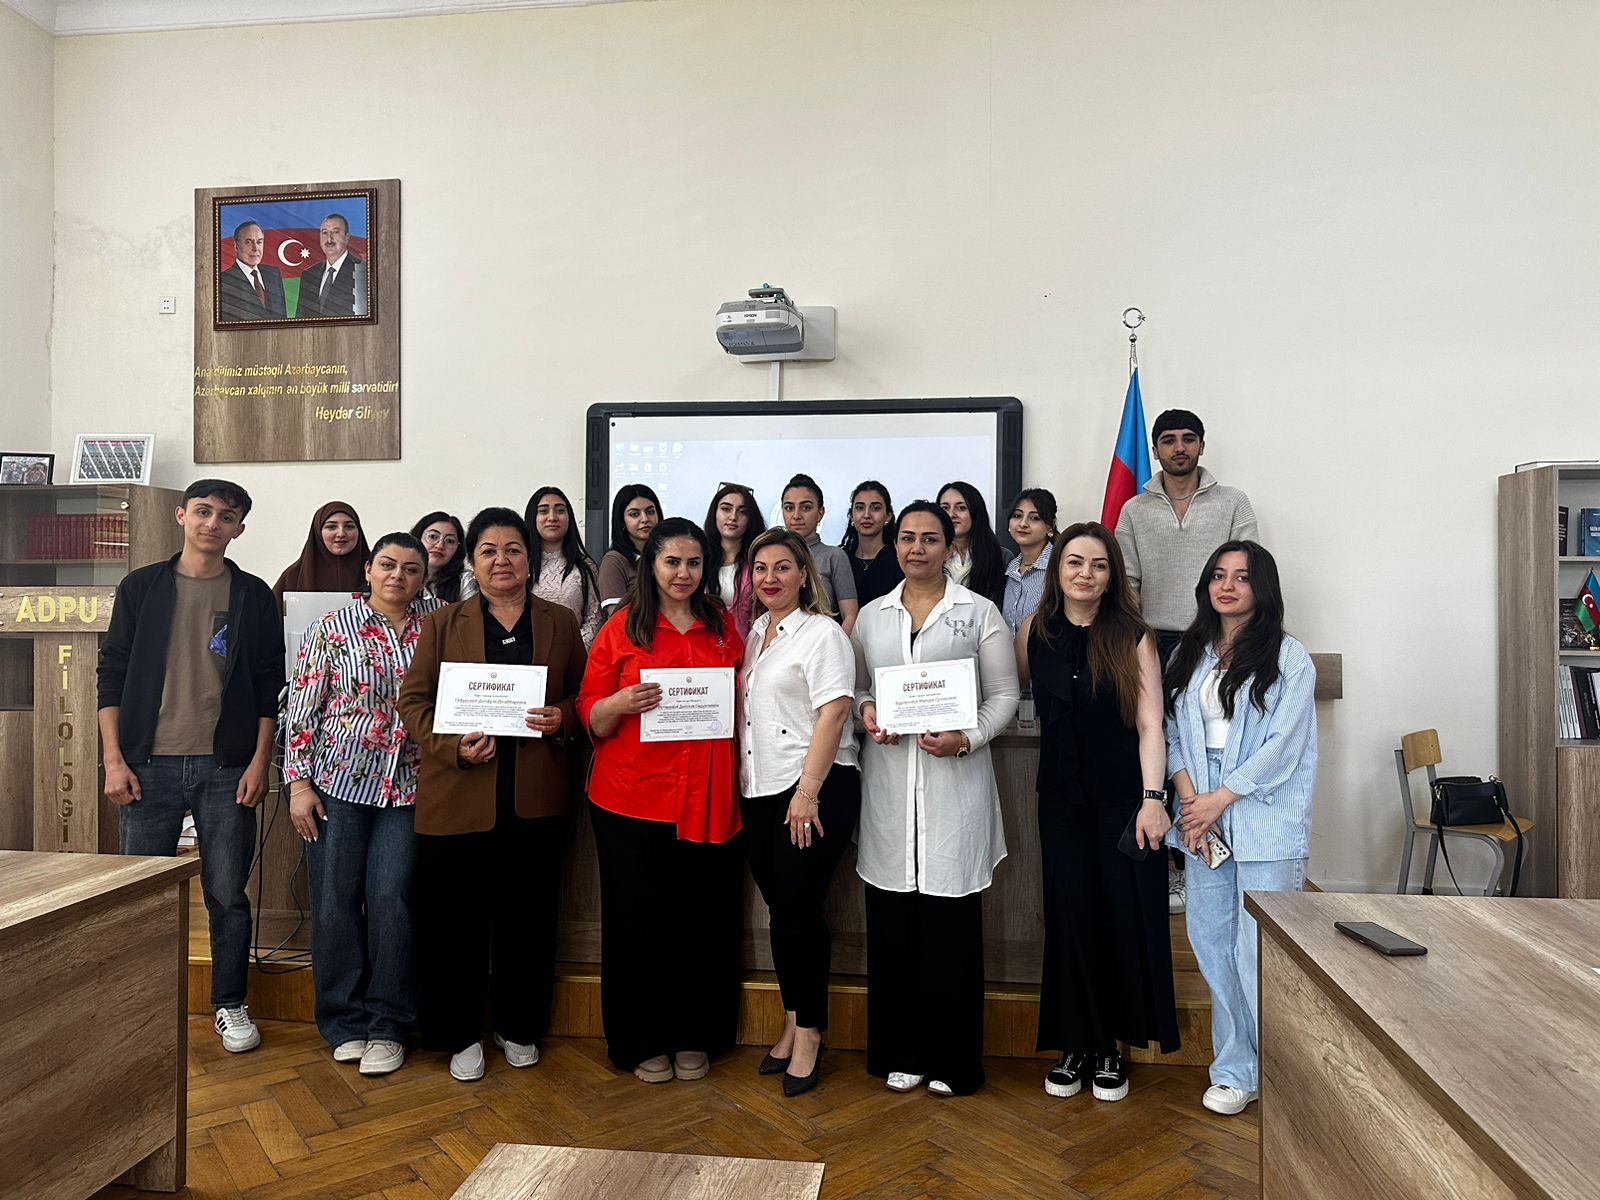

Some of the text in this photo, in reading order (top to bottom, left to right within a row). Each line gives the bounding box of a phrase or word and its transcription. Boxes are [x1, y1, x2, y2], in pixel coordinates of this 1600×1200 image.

[244, 364, 283, 378] müstəqil
[286, 385, 298, 394] ən
[300, 382, 328, 397] böyük
[330, 381, 350, 394] milli
[315, 406, 354, 423] Heydər
[15, 595, 98, 623] ADPU
[468, 681, 516, 692] СЕРТИФИКАТ
[668, 686, 709, 697] СЕРТИФИКАТ
[903, 680, 946, 692] СЕРТИФИКАТ
[57, 645, 74, 853] FİLOLOGİ
